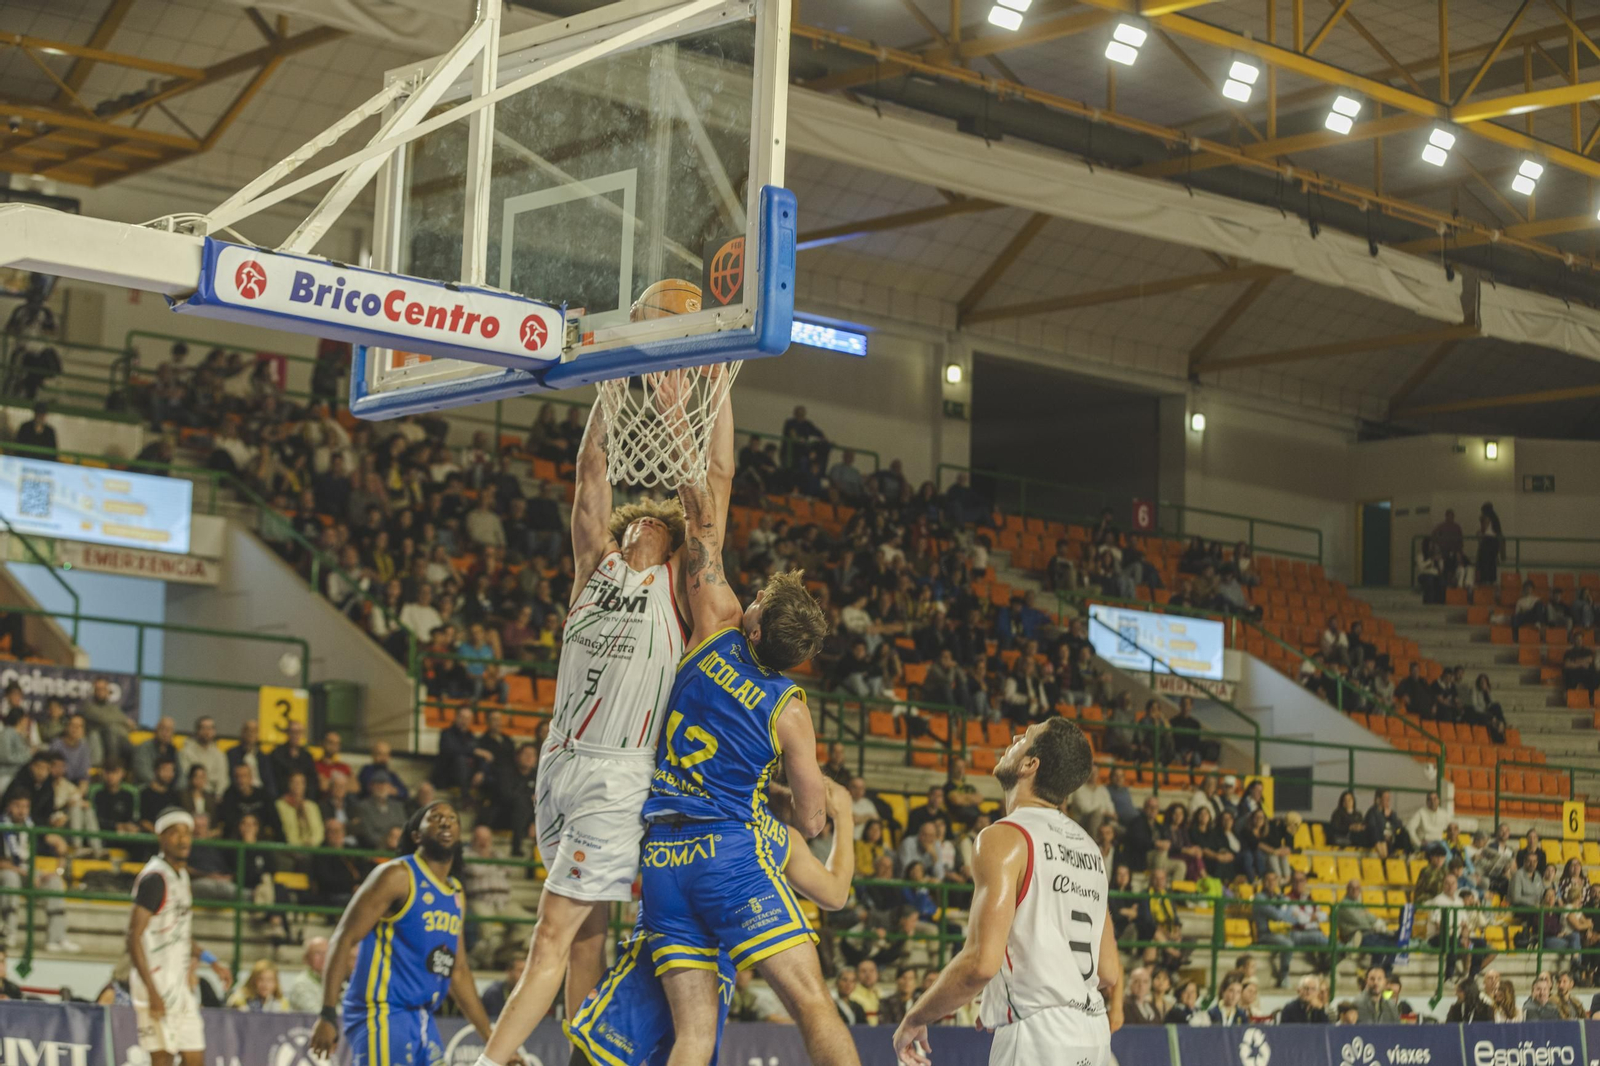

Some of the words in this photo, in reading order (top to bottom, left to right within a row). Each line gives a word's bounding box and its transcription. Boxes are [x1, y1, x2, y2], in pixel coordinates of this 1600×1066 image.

[289, 270, 500, 339] BricoCentro
[1137, 505, 1149, 527] 6
[584, 668, 601, 696] 9
[697, 650, 767, 710] NICOLAU
[273, 699, 291, 733] 3
[1569, 809, 1579, 834] 6
